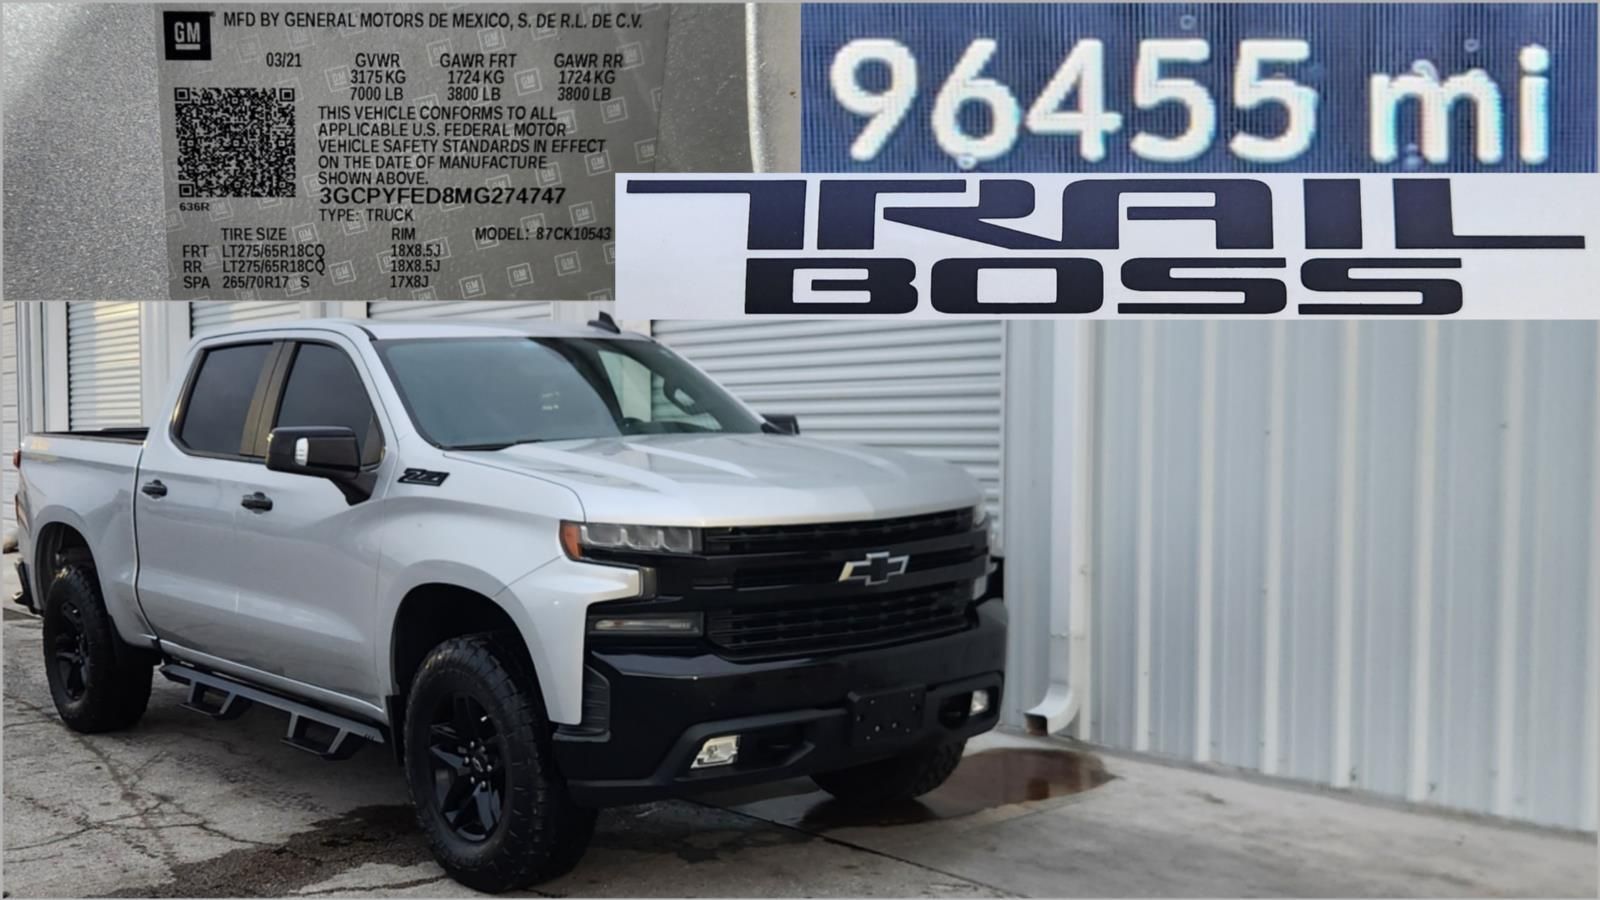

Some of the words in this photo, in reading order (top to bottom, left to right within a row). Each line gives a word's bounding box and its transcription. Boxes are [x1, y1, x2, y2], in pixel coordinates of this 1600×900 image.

[223, 11, 256, 27] MFD
[260, 11, 280, 27] BY
[284, 11, 356, 28] GENERAL
[360, 12, 424, 28] MOTORS
[428, 12, 448, 28] DE
[452, 12, 514, 31] MEXICO,
[517, 12, 532, 29] S.
[536, 12, 556, 29] DE
[560, 13, 587, 29] R.L.
[592, 13, 612, 29] DE
[615, 12, 643, 29] C.V.
[174, 21, 201, 43] GM
[265, 51, 302, 68] 03/21
[355, 52, 400, 68] GVWR
[439, 52, 485, 68] GAWR
[489, 53, 517, 68] FRT
[554, 52, 599, 68] GAWR
[602, 53, 624, 68] RR
[350, 69, 383, 85] 3175
[385, 69, 406, 85] KG
[448, 69, 480, 85] 1724
[483, 69, 505, 85] KG
[559, 69, 592, 85] 1724
[594, 69, 616, 85] KG
[351, 85, 382, 101] 7000
[385, 86, 404, 101] LB
[447, 86, 479, 101] 3800
[482, 86, 501, 102] LB
[558, 86, 590, 101] 3800
[592, 86, 612, 102] LB
[829, 37, 1320, 166] 96455
[1368, 43, 1552, 166] mi
[318, 105, 351, 120] THIS
[354, 105, 416, 121] VEHICLE
[419, 105, 503, 121] CONFORMS
[508, 105, 527, 121] TO
[529, 106, 557, 121] ALL
[318, 122, 408, 137] APPLICABLE
[412, 121, 440, 137] U.S.
[444, 122, 510, 137] FEDERAL
[514, 122, 566, 137] MOTOR
[318, 138, 379, 153] VEHICLE
[383, 138, 439, 153] SAFETY
[442, 138, 530, 153] STANDARDS
[533, 139, 547, 153] IN
[551, 138, 606, 154] EFFECT
[318, 154, 339, 169] ON
[343, 155, 371, 169] THE
[375, 155, 411, 170] DATE
[415, 154, 435, 169] OF
[439, 154, 547, 170] MANUFACTURE
[318, 170, 372, 185] SHOWN
[375, 171, 429, 185] ABOVE.
[320, 186, 566, 205] 3GCPYFED8MG274747
[179, 202, 210, 212] 636R
[319, 208, 360, 222] TYPE:
[366, 207, 414, 222] TRUCK
[626, 178, 1586, 250] TRAIL
[220, 227, 252, 241] TIRE
[255, 226, 287, 241] SIZE
[391, 227, 416, 241] RIM
[475, 226, 529, 241] MODEL:
[536, 226, 612, 241] 87CK10543
[182, 244, 209, 258] FRT
[222, 243, 326, 261] LT275/65R18CQ
[391, 243, 441, 258] 18X8.5J
[183, 260, 202, 273] RR
[222, 258, 326, 277] LT275/65R18CQ
[391, 258, 441, 273] 18X8.5J
[183, 275, 211, 289] SPA
[222, 275, 289, 289] 265/70R17
[300, 274, 310, 289] S
[390, 274, 429, 289] 17X8J
[744, 256, 1463, 315] BOSS
